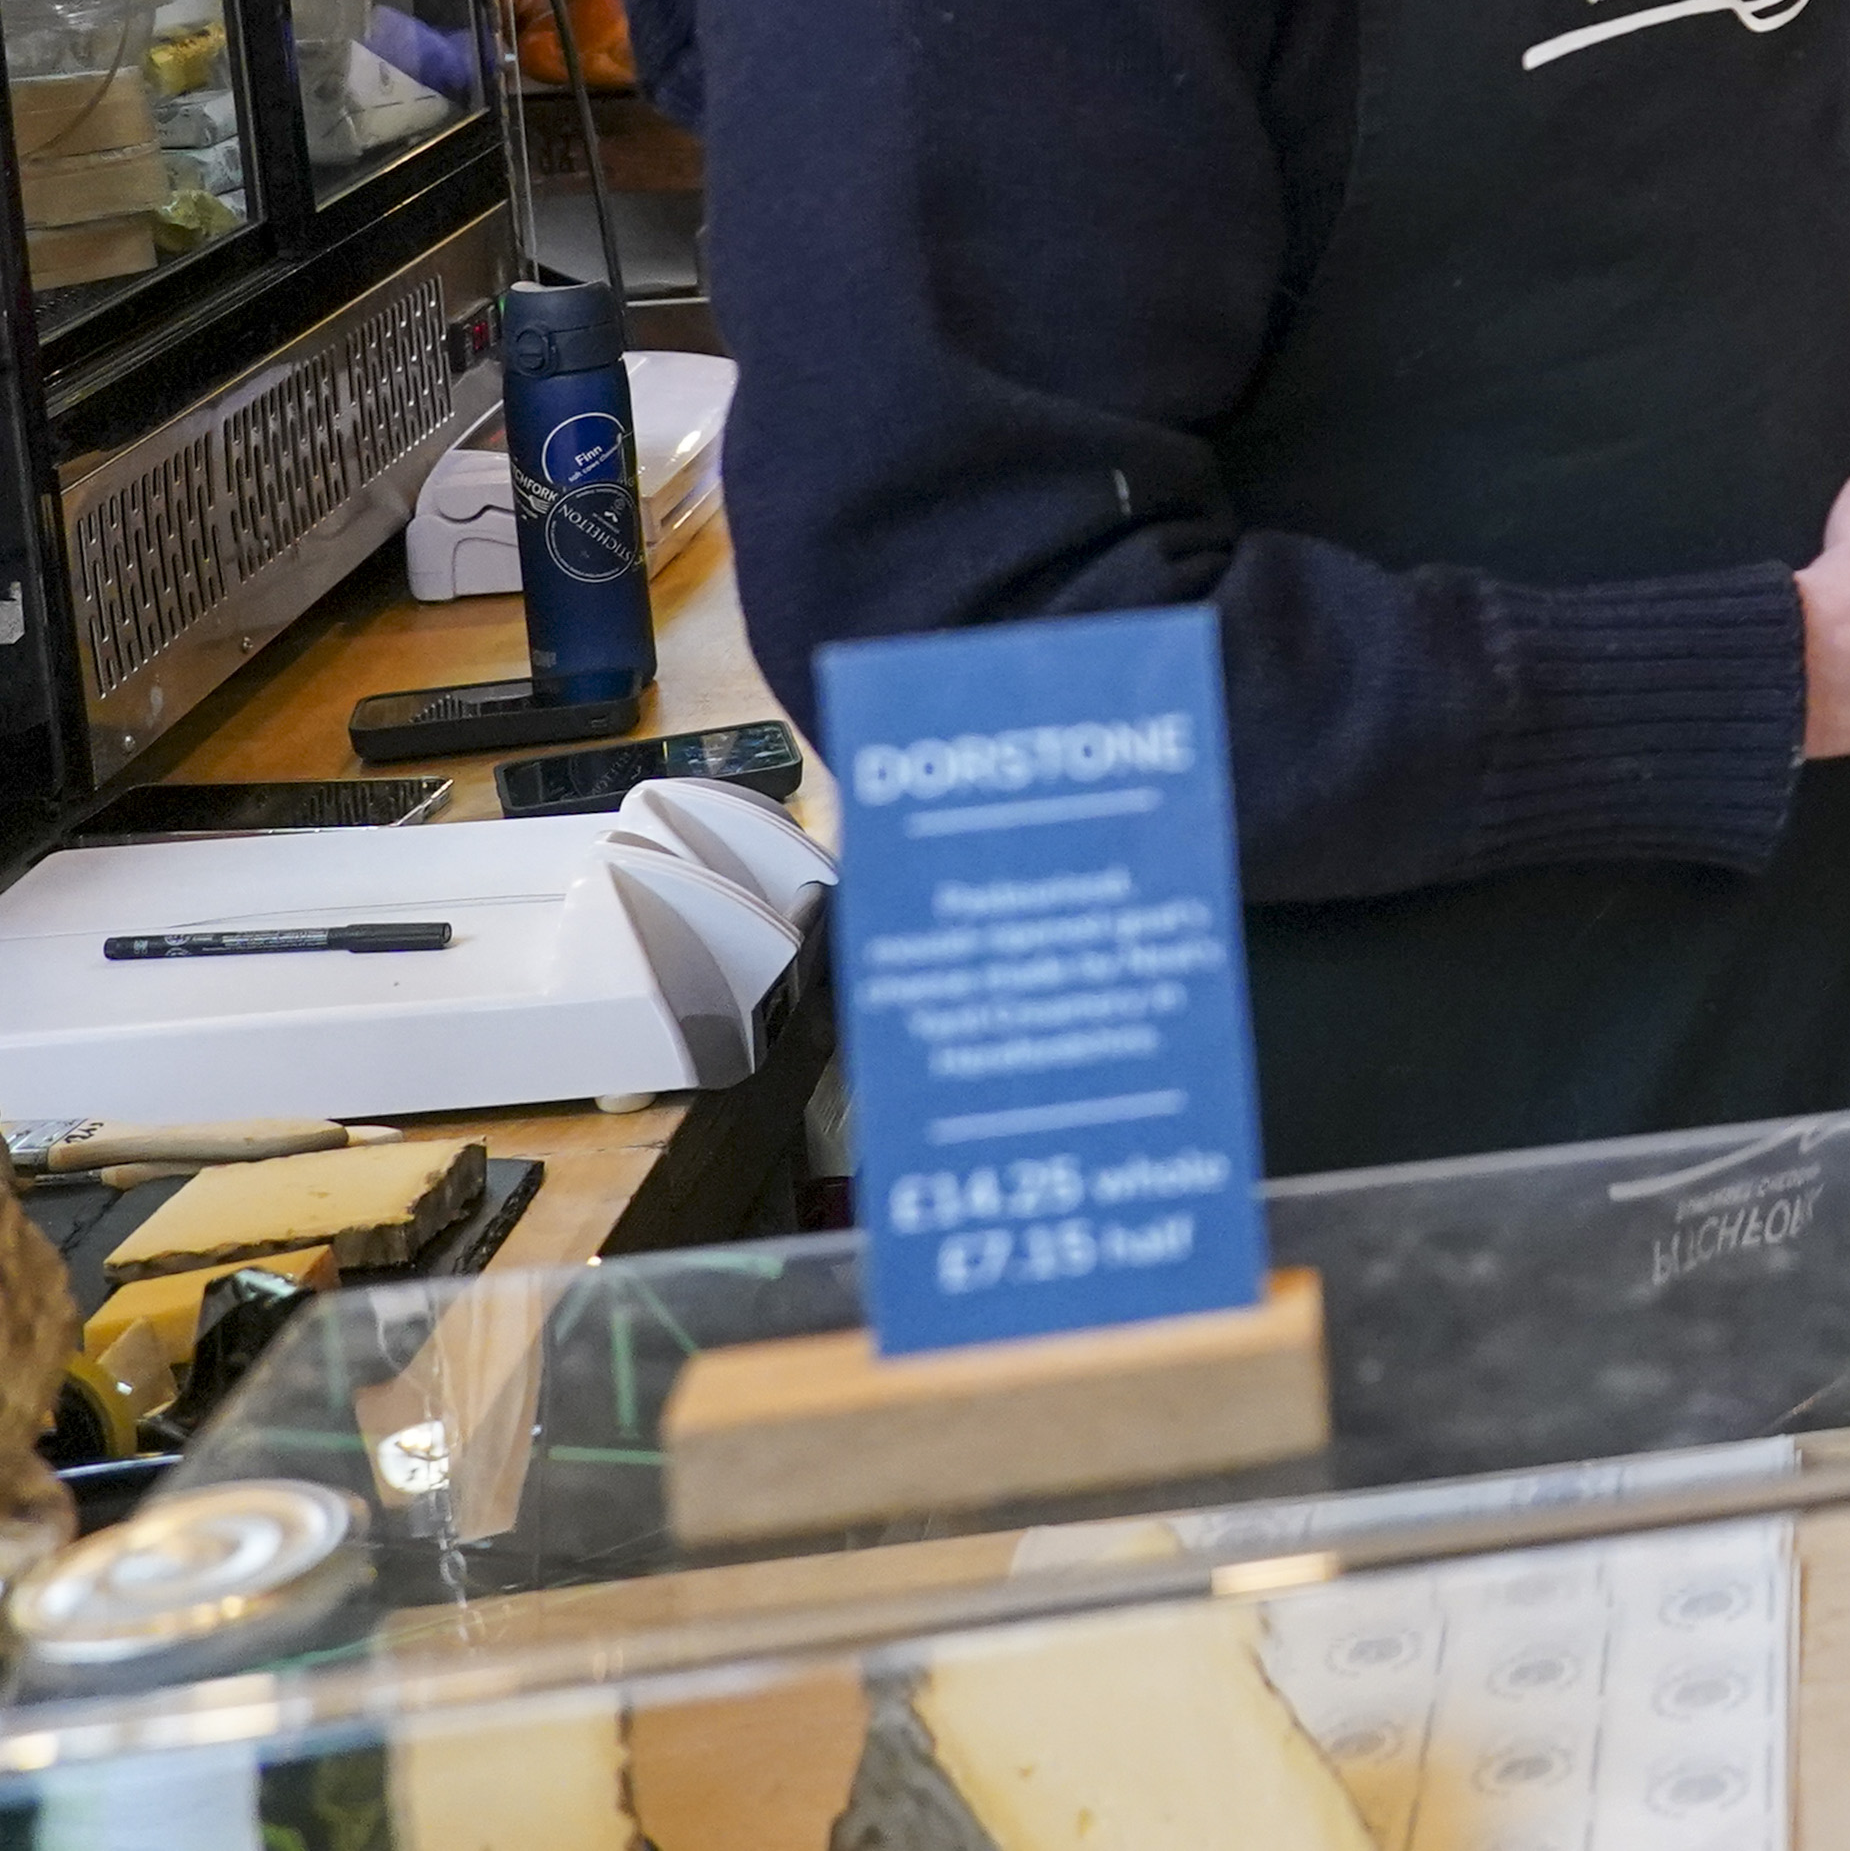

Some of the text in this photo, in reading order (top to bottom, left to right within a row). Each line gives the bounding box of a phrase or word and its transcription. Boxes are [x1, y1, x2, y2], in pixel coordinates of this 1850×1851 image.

[574, 445, 604, 467] Finn
[558, 503, 633, 562] STICHELTON
[852, 713, 1198, 810] DORSTONE
